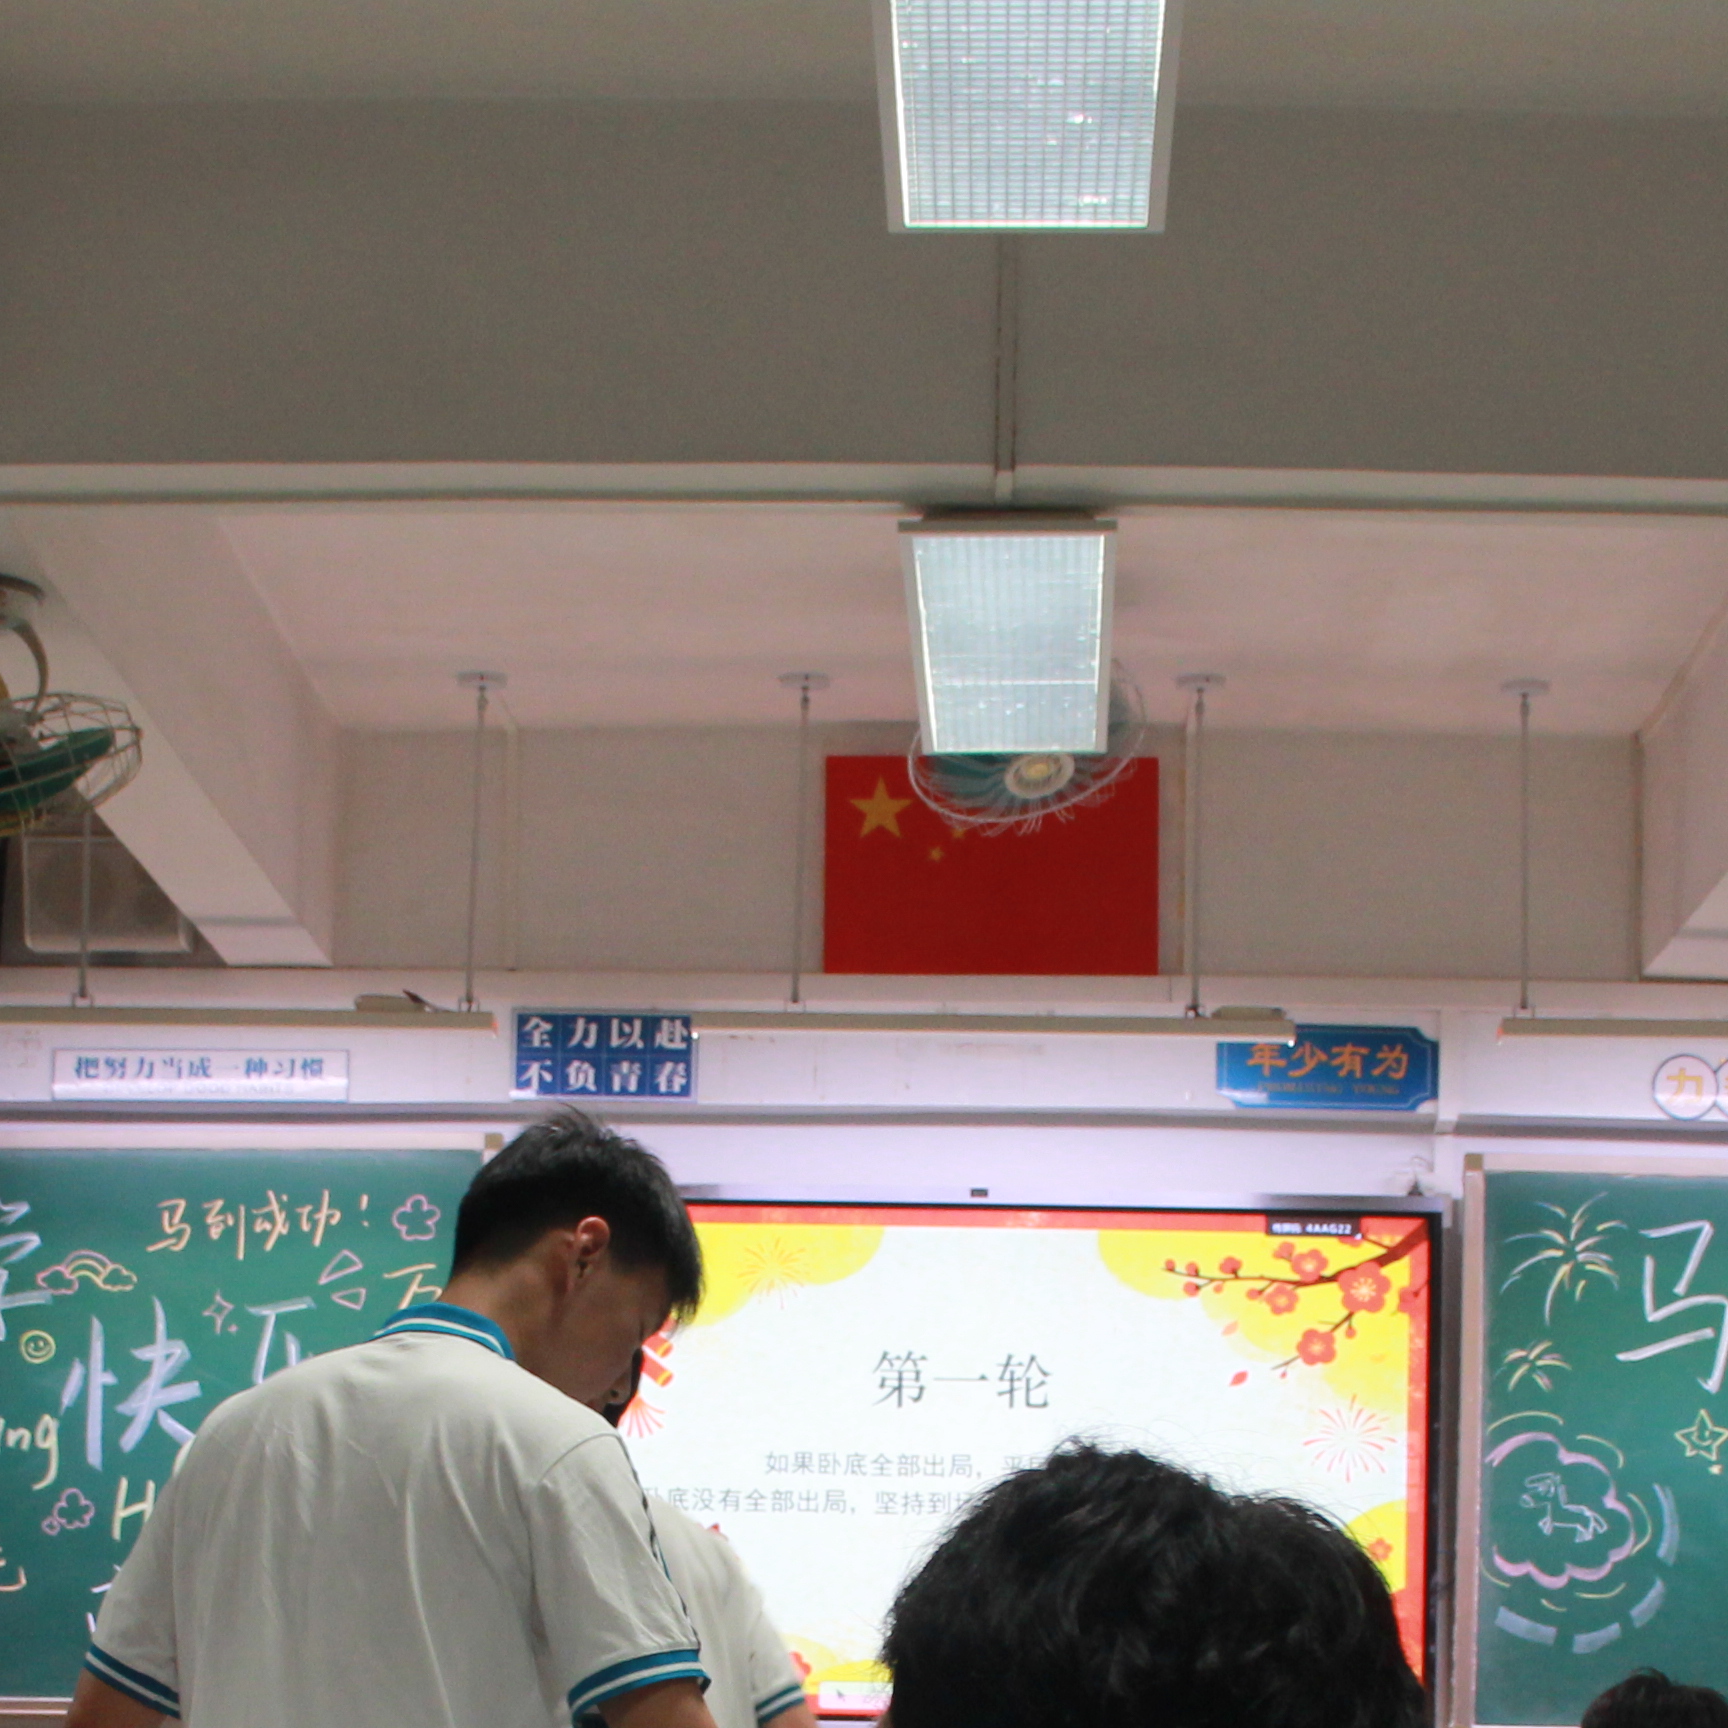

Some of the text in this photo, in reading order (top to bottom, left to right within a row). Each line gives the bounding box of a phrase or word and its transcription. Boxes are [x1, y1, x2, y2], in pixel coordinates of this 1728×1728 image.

[518, 1014, 691, 1050] 全力以赴
[74, 1055, 325, 1080] 把努力当成一种习惯
[517, 1056, 689, 1095] 不负青春
[1246, 1041, 1409, 1080] 年少有为
[871, 1349, 1052, 1411] 第一轮
